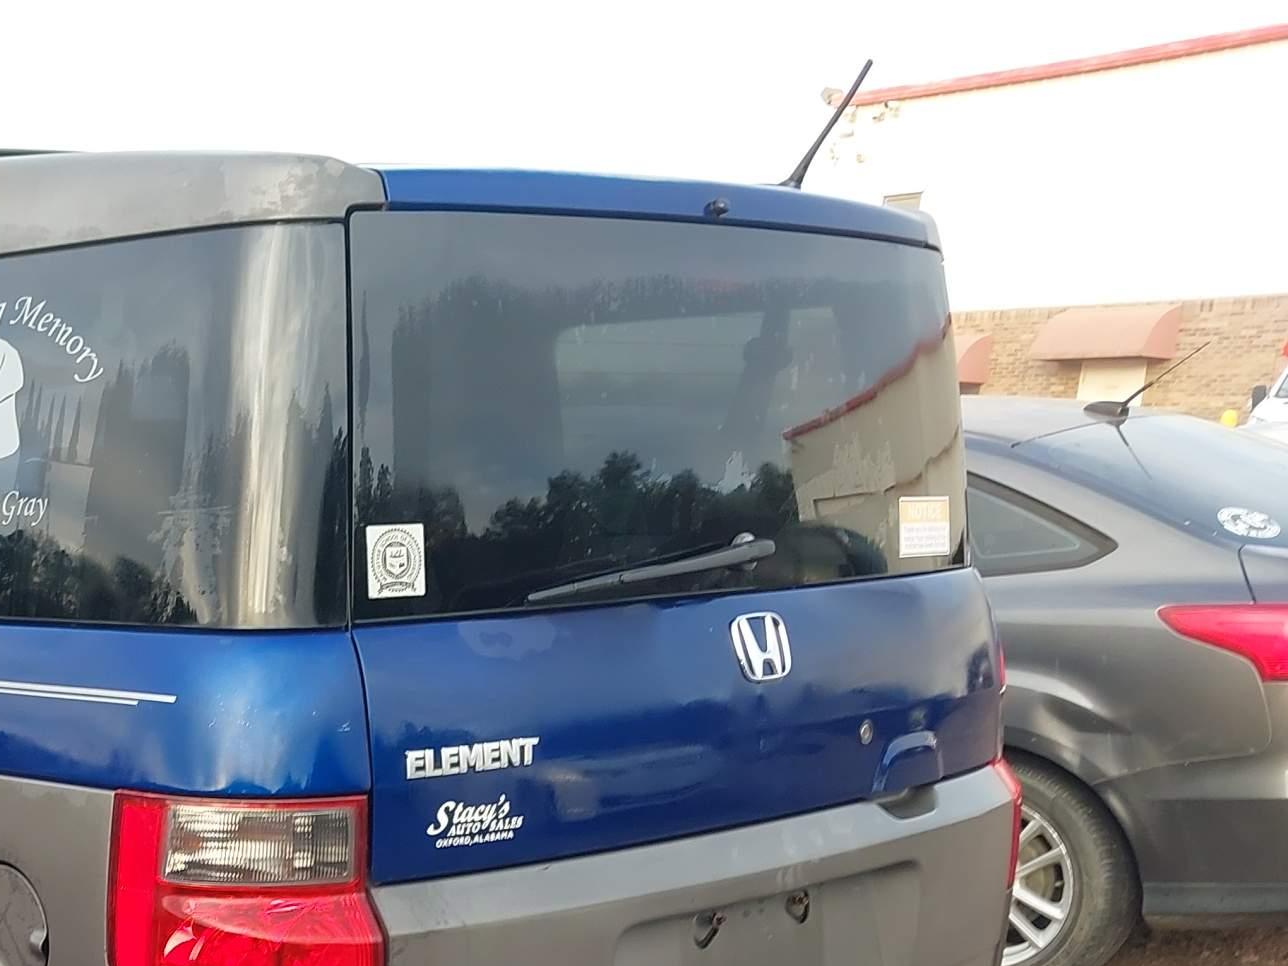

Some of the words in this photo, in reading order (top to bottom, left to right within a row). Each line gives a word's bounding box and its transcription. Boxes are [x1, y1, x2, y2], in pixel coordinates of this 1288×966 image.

[10, 296, 104, 383] Memory
[2, 491, 49, 526] Gray
[405, 737, 540, 780] ELEMENT
[426, 794, 510, 836] Stacy's
[447, 822, 481, 837] AUTO
[489, 816, 524, 832] SALES
